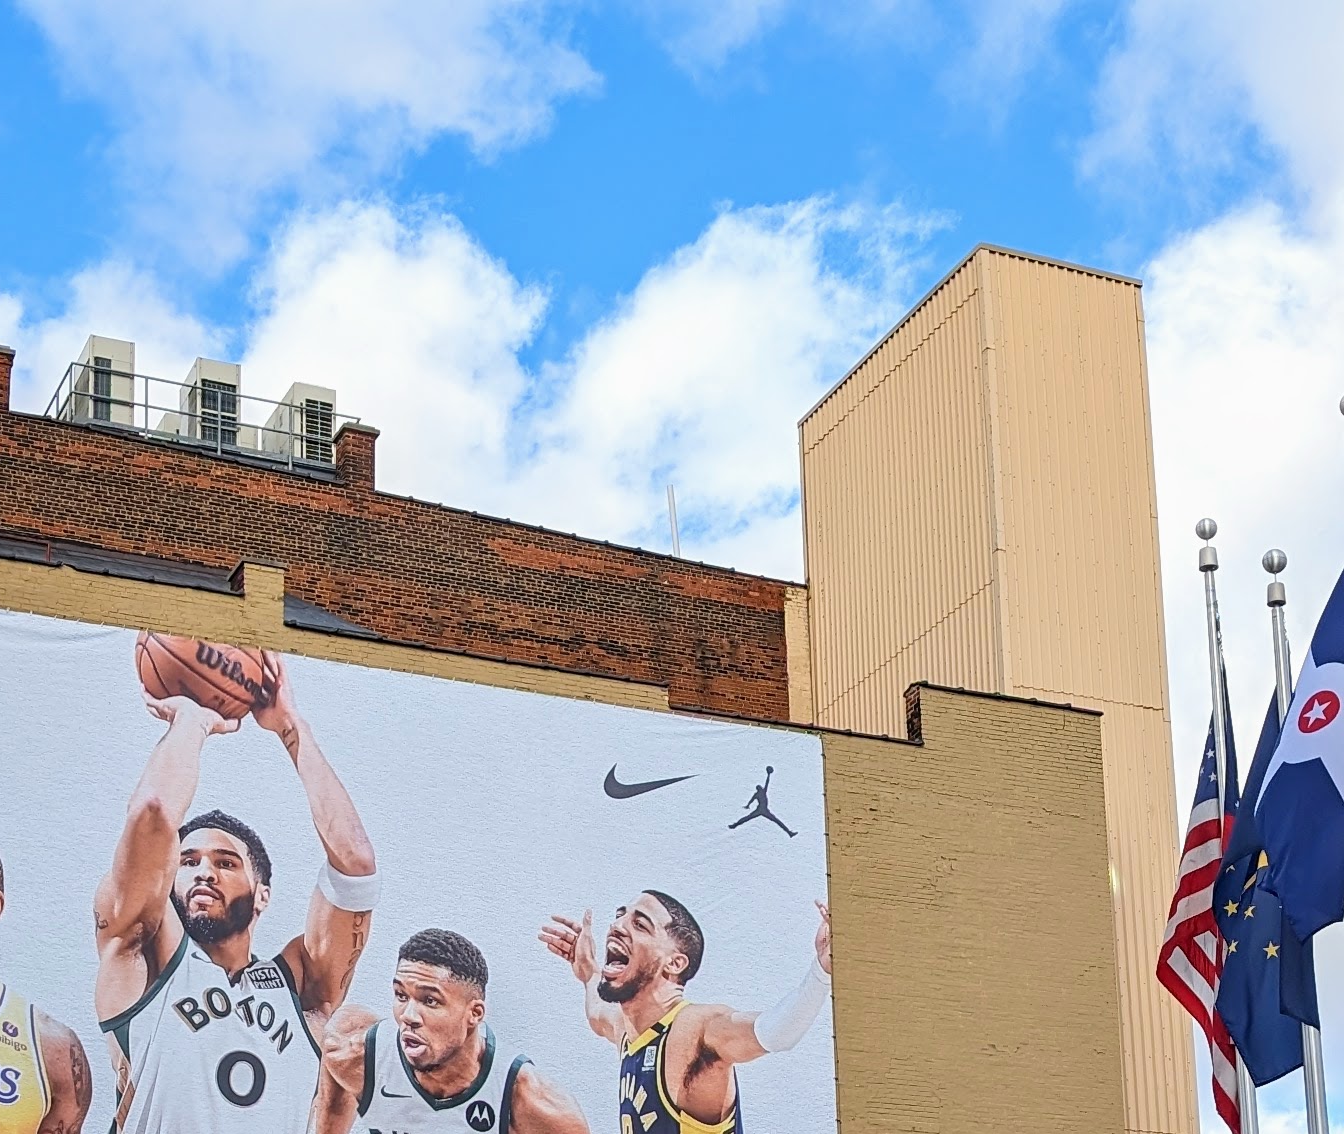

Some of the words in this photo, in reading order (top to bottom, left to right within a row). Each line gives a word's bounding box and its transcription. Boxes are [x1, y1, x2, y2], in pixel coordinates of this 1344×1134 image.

[248, 966, 279, 980] VISTA
[254, 979, 282, 989] PRINT
[172, 987, 293, 1054] BOTON
[215, 1050, 267, 1108] 0
